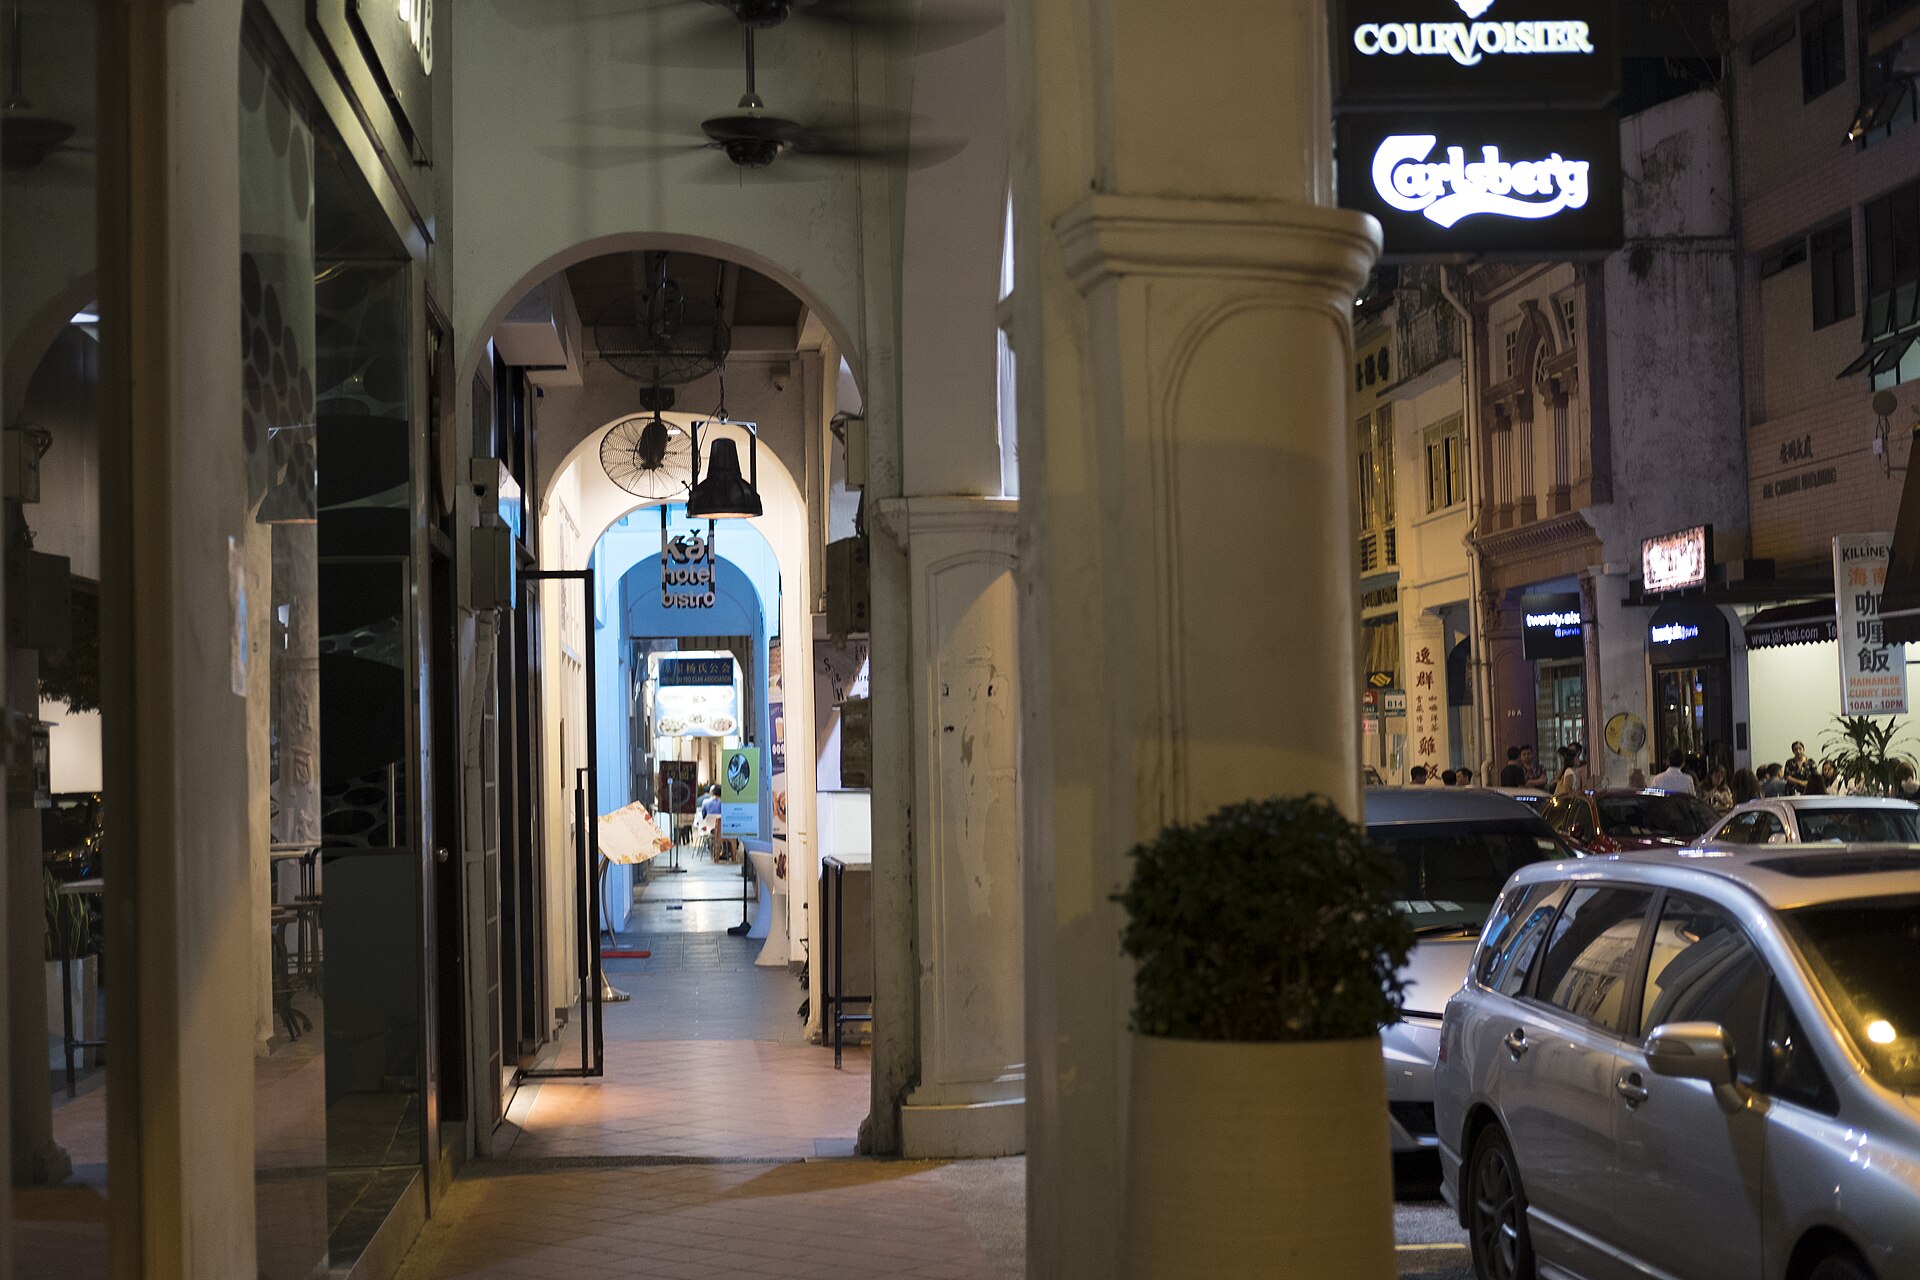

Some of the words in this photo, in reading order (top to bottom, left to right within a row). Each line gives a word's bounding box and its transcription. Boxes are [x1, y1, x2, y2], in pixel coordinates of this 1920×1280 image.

[1354, 20, 1594, 66] COURVOISIER
[1371, 134, 1590, 216] Carlsberg
[661, 563, 716, 584] hotel
[661, 589, 716, 607] bistro
[1850, 676, 1899, 687] HAINANESE
[1849, 688, 1878, 698] CURRY
[1881, 687, 1901, 697] RICE
[1849, 701, 1873, 710] 10AM
[1881, 700, 1904, 710] 10PM
